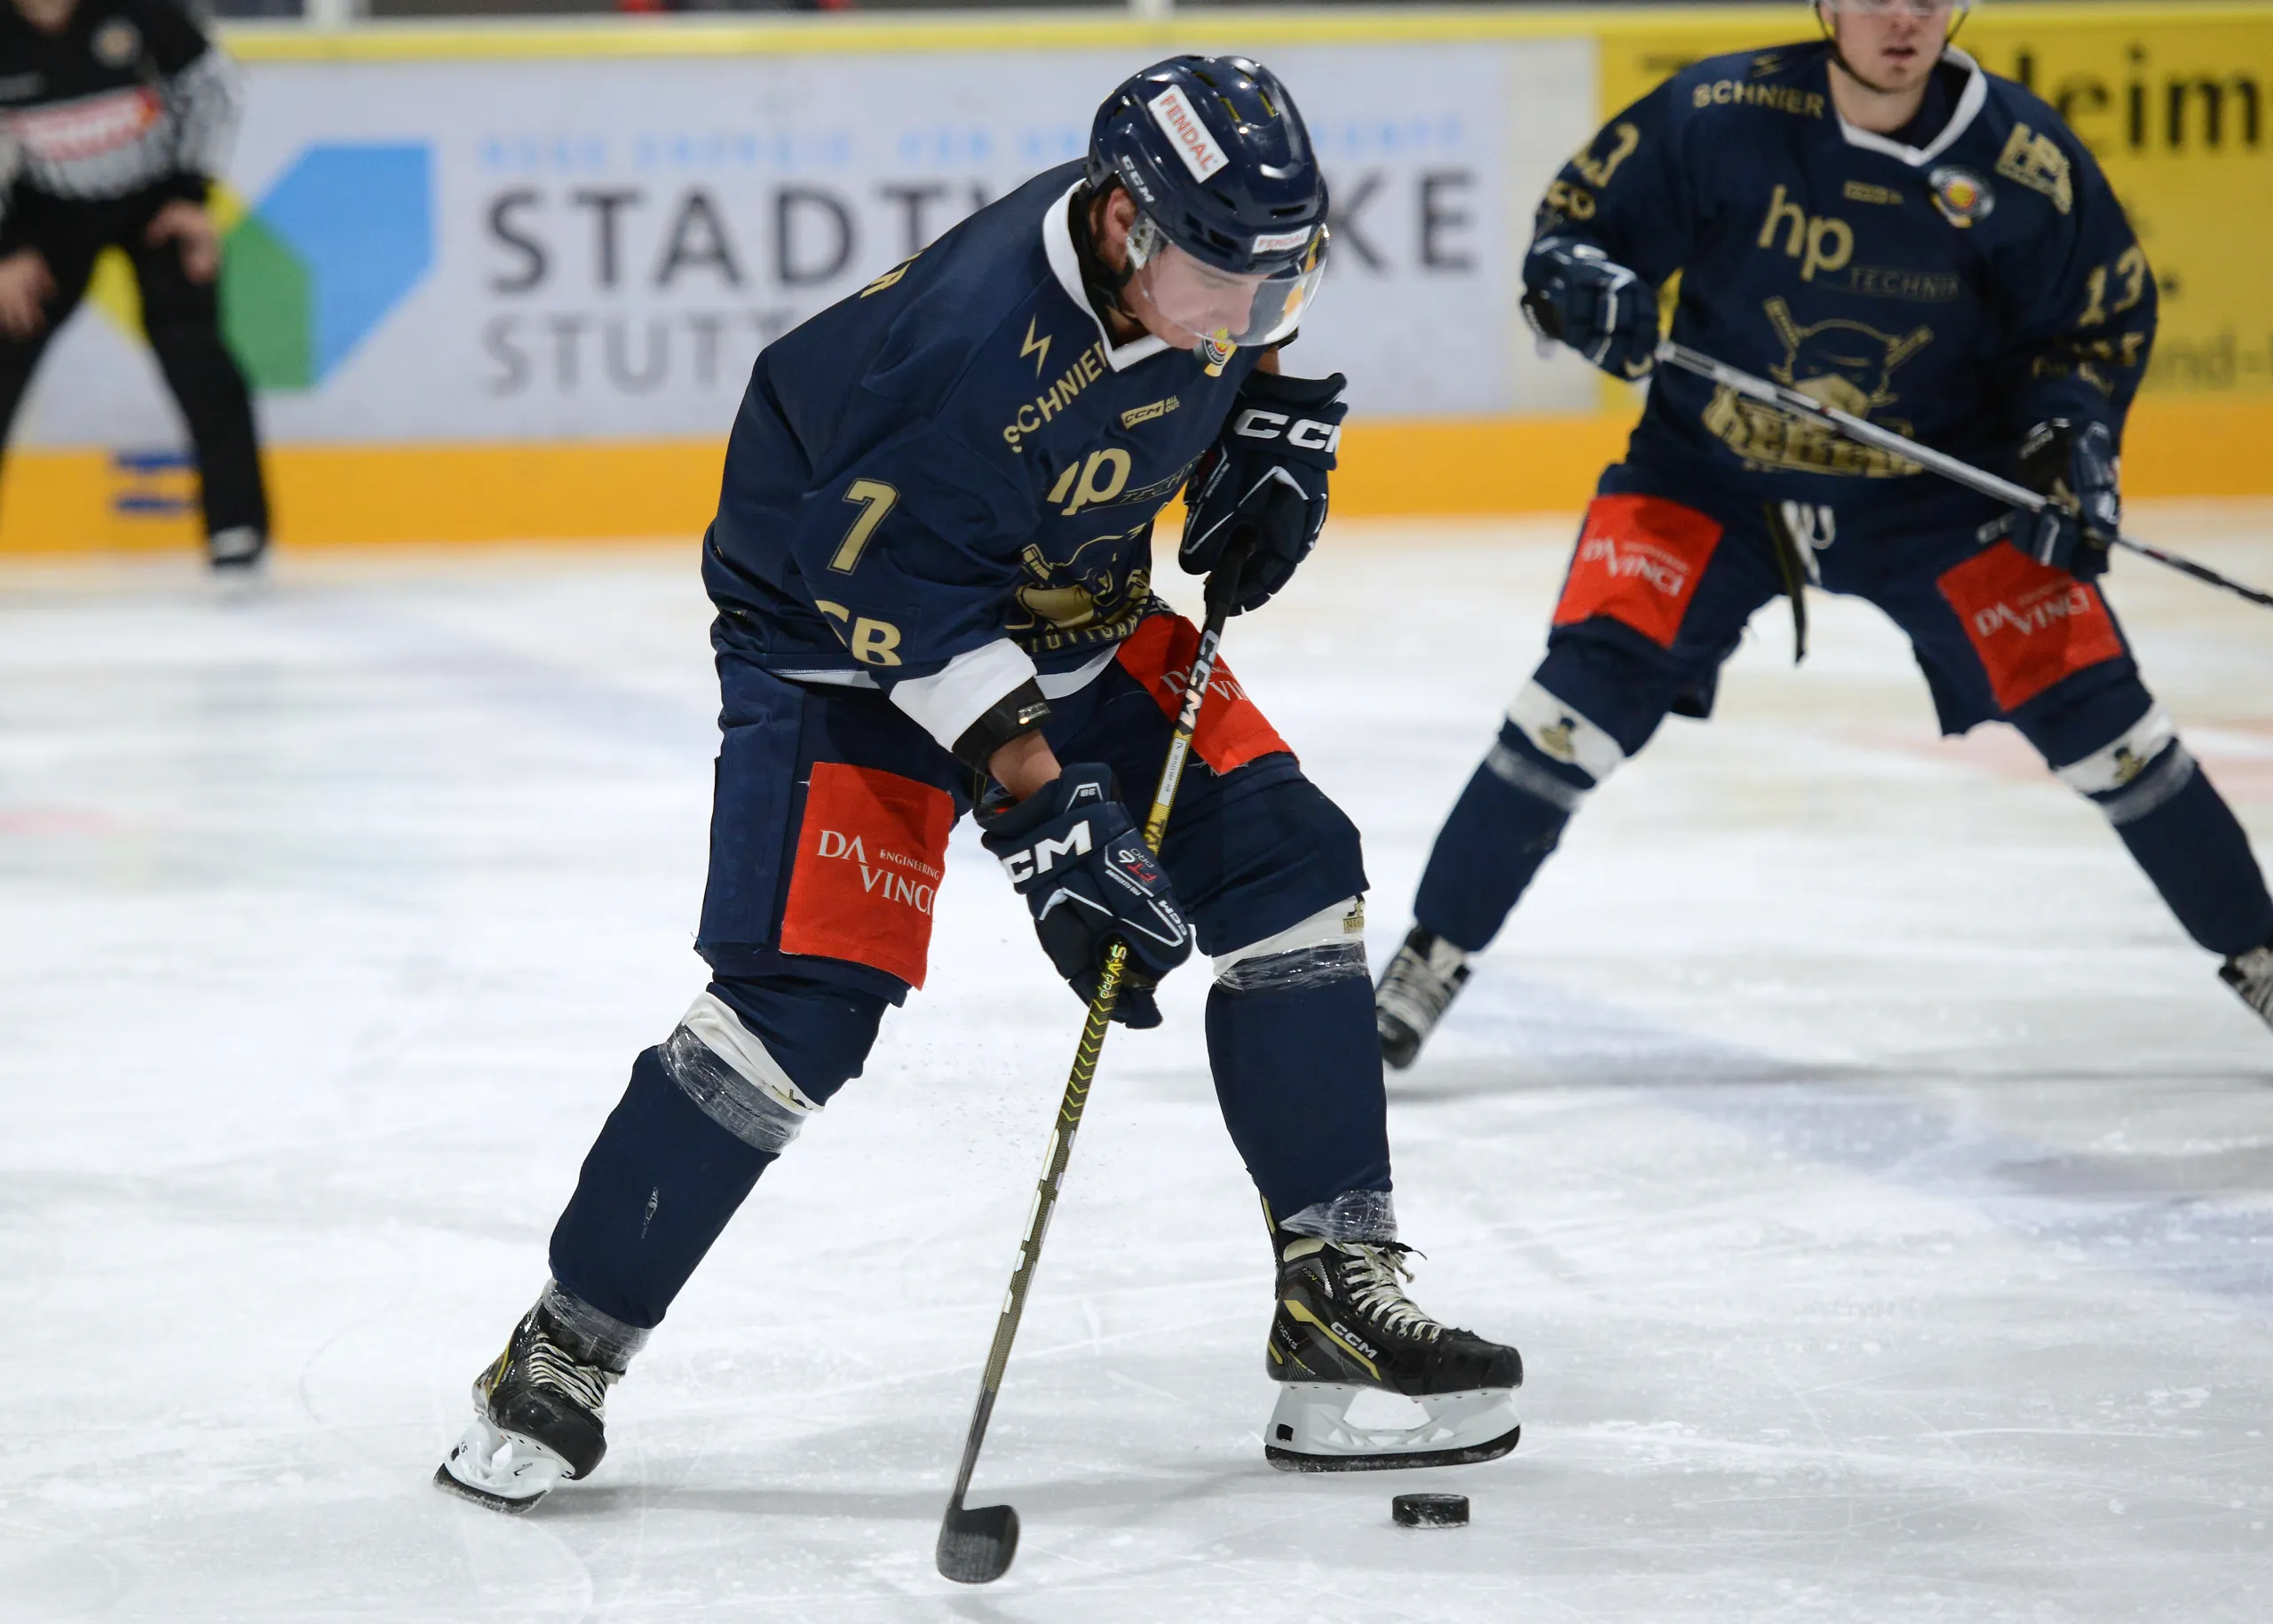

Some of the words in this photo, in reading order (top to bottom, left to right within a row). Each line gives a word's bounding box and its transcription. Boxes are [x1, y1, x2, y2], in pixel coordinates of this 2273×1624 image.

[1692, 79, 1824, 119] SCHNIER
[2017, 43, 2261, 151] eim
[1160, 93, 1214, 171] FENDAL
[1121, 154, 1154, 202] CCM
[1258, 233, 1304, 249] FENDAL
[1757, 184, 1854, 281] hp
[2079, 245, 2145, 326] 13
[1123, 405, 1163, 426] CCM
[1166, 395, 1178, 405] ALL
[1166, 401, 1180, 413] OUT
[827, 478, 900, 575] 7
[1160, 666, 1193, 695] D
[1180, 629, 1219, 725] CCM
[817, 830, 867, 864] DA
[880, 849, 939, 880] ENGINEERING
[1002, 820, 1092, 883] CM
[1130, 847, 1155, 868] PRO
[859, 864, 934, 915] VINCI
[1158, 899, 1188, 936] CCM
[1100, 973, 1114, 1000] PRO
[1277, 1319, 1298, 1350] TACKS
[1331, 1321, 1377, 1359] CCM
